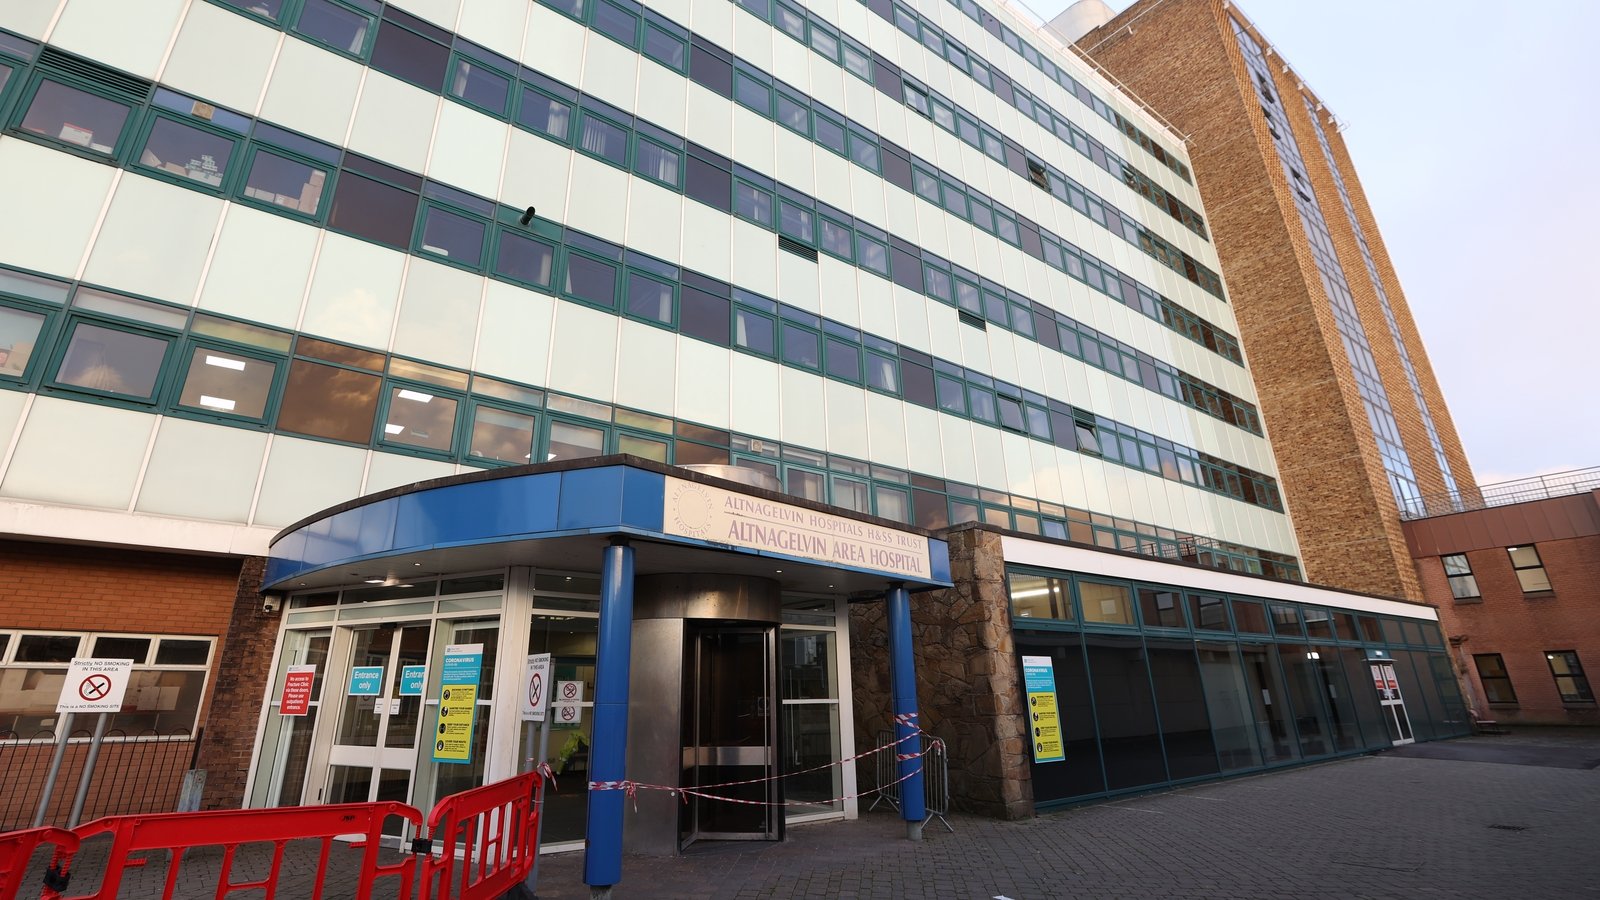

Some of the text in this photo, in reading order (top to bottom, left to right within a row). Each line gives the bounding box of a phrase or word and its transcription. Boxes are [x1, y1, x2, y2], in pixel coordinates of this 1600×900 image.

[672, 482, 713, 510] ALTNAGELVIN
[674, 515, 712, 537] HOSPITALS
[724, 495, 923, 550] ALTNAGELVIN HOSPITALS H&SS TRUST
[728, 519, 923, 573] ALTNAGELVIN AREA HOSPITAL
[354, 671, 379, 679] Entrance
[405, 670, 425, 679] Entran
[358, 681, 371, 691] only
